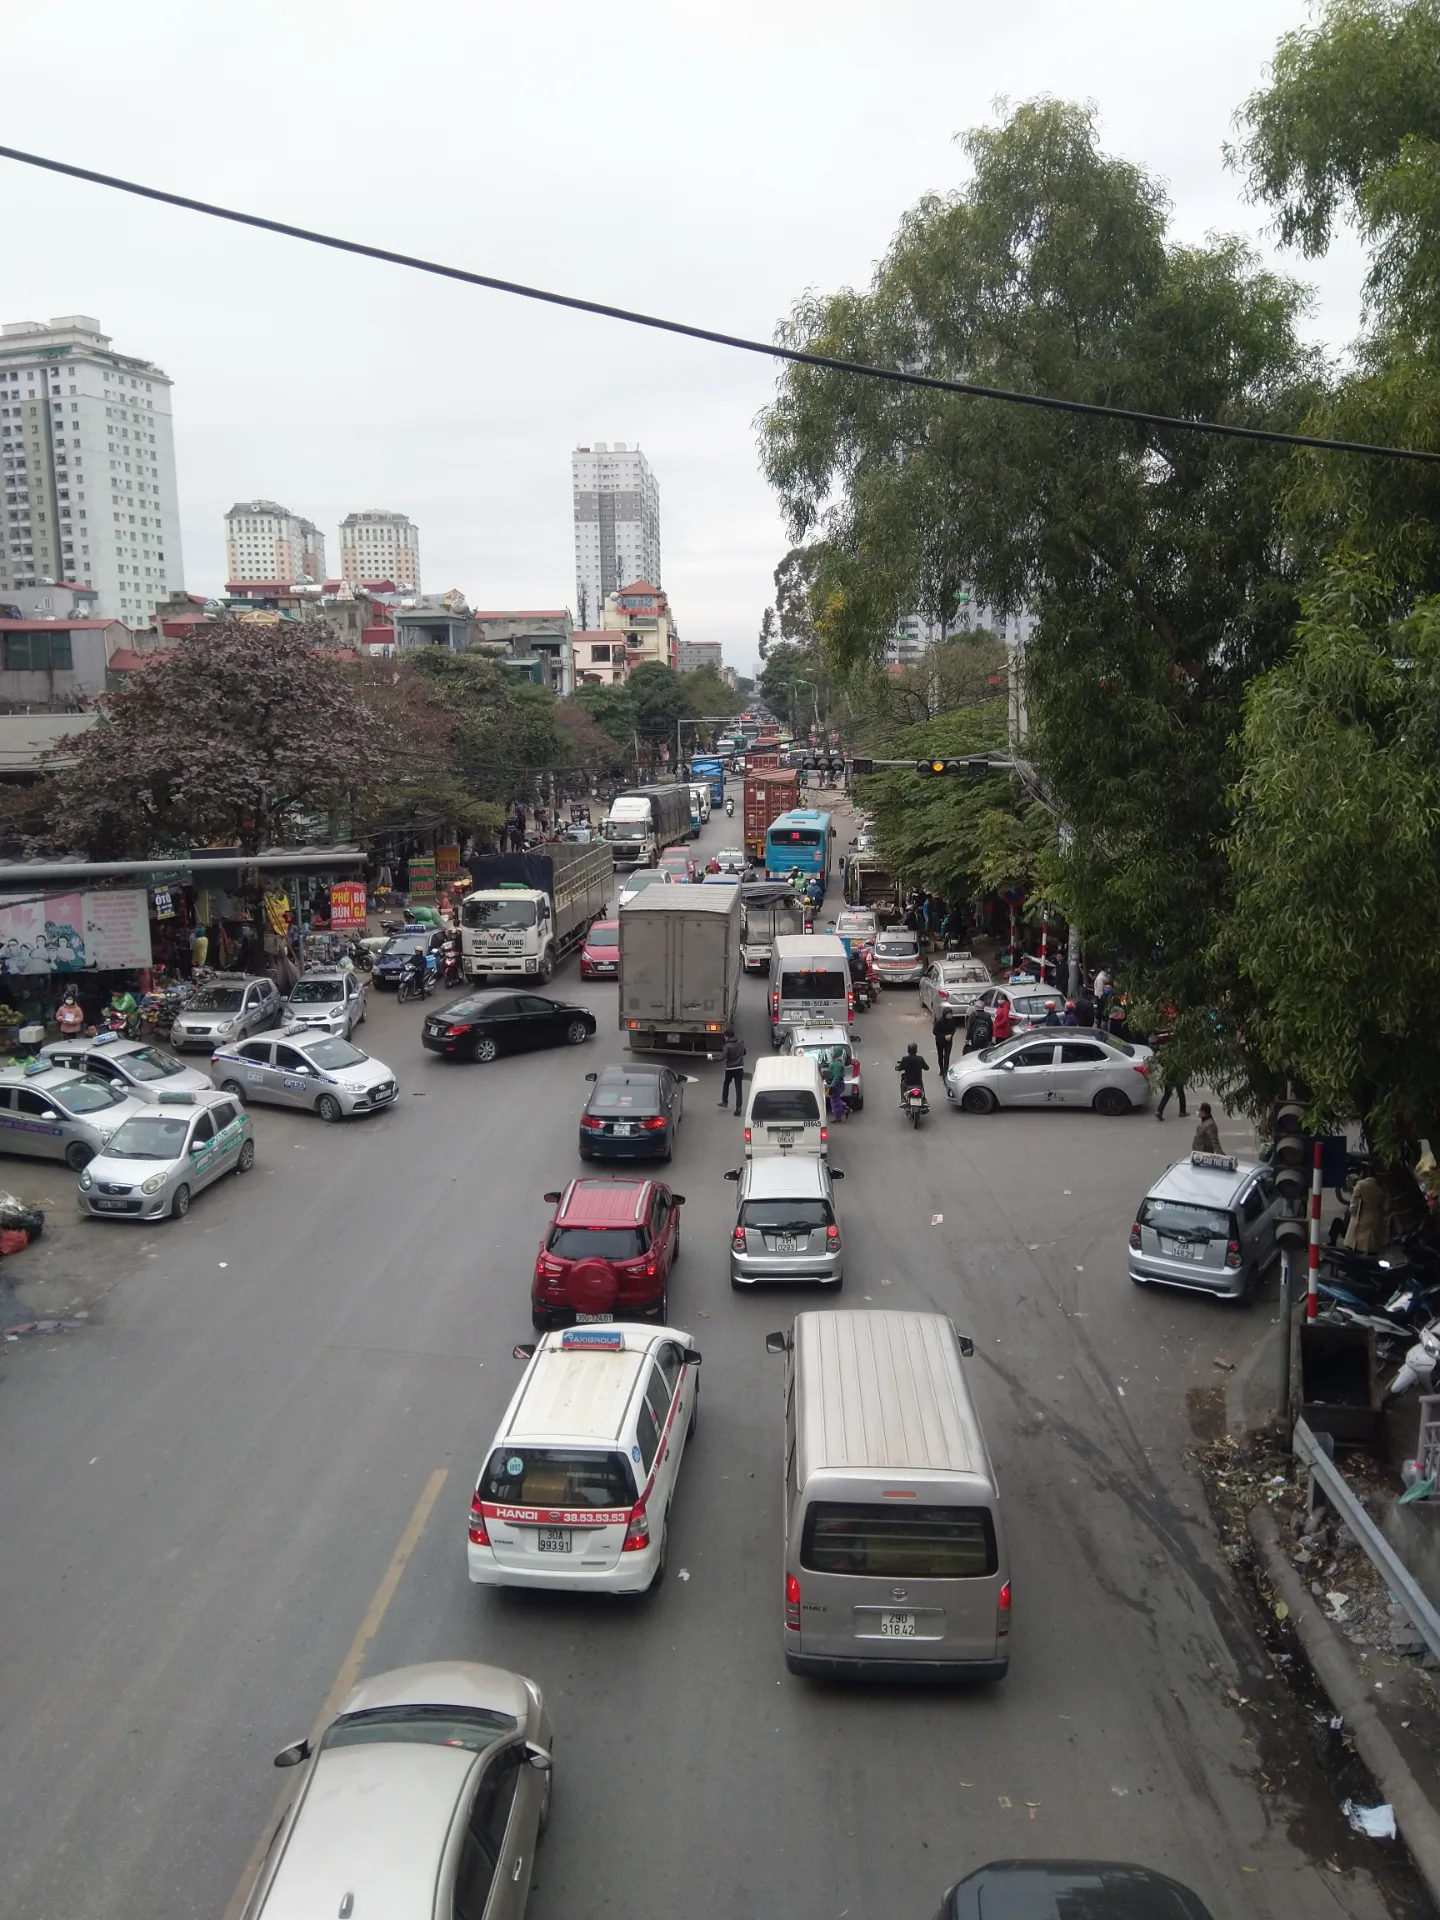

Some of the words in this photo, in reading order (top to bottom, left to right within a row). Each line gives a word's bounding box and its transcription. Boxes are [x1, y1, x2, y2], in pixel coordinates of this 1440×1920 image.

[332, 888, 350, 904] PHỞ
[332, 904, 350, 918] BÚN
[570, 1336, 620, 1344] TAXIGROUP
[496, 1507, 538, 1520] HANOI
[563, 1513, 626, 1522] 38.53.53.53
[547, 1530, 564, 1540] 30A
[540, 1539, 570, 1551] 993.91
[888, 1613, 908, 1624] 29D
[882, 1623, 915, 1636] 318.42
